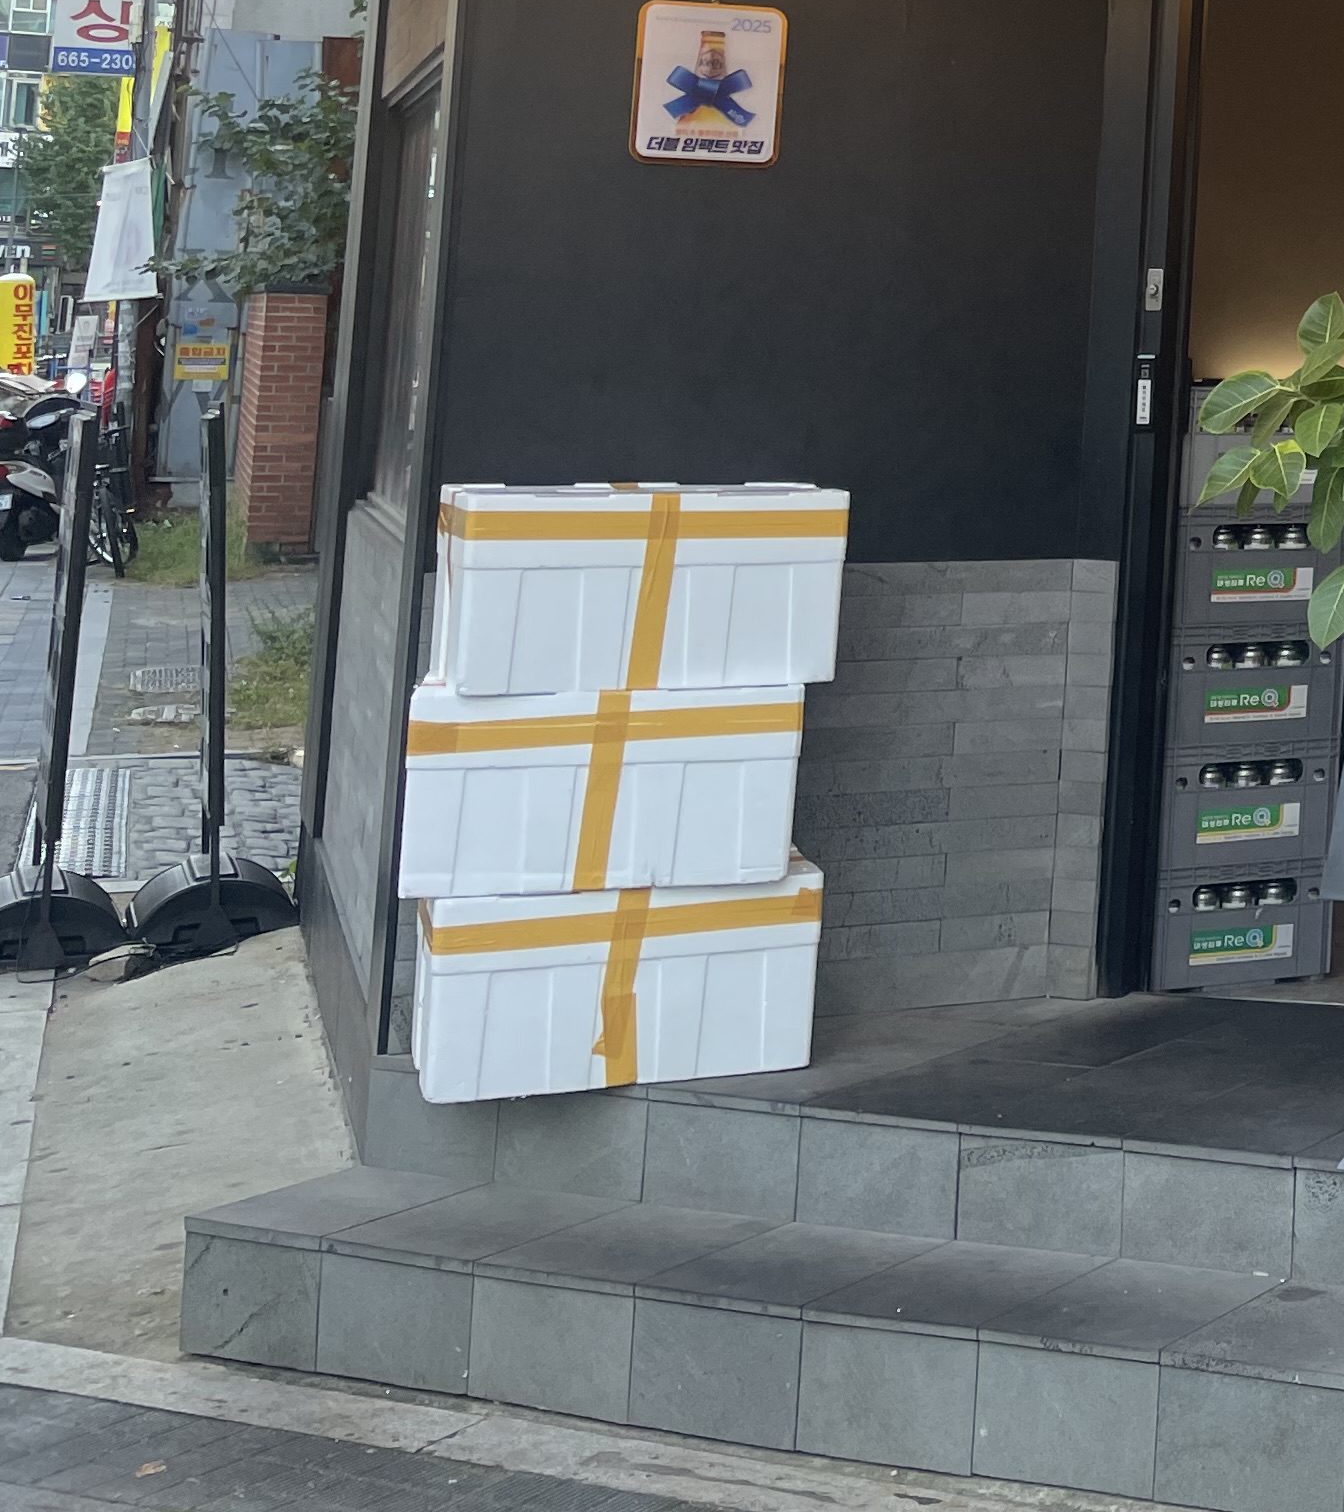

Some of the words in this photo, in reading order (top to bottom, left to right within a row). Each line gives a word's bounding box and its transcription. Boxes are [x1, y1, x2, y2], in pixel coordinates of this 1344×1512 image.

[731, 17, 773, 34] 2025
[56, 51, 136, 72] 665-230
[646, 136, 681, 152] 더블
[681, 137, 731, 154] 임팩트
[730, 139, 766, 155] 맛집
